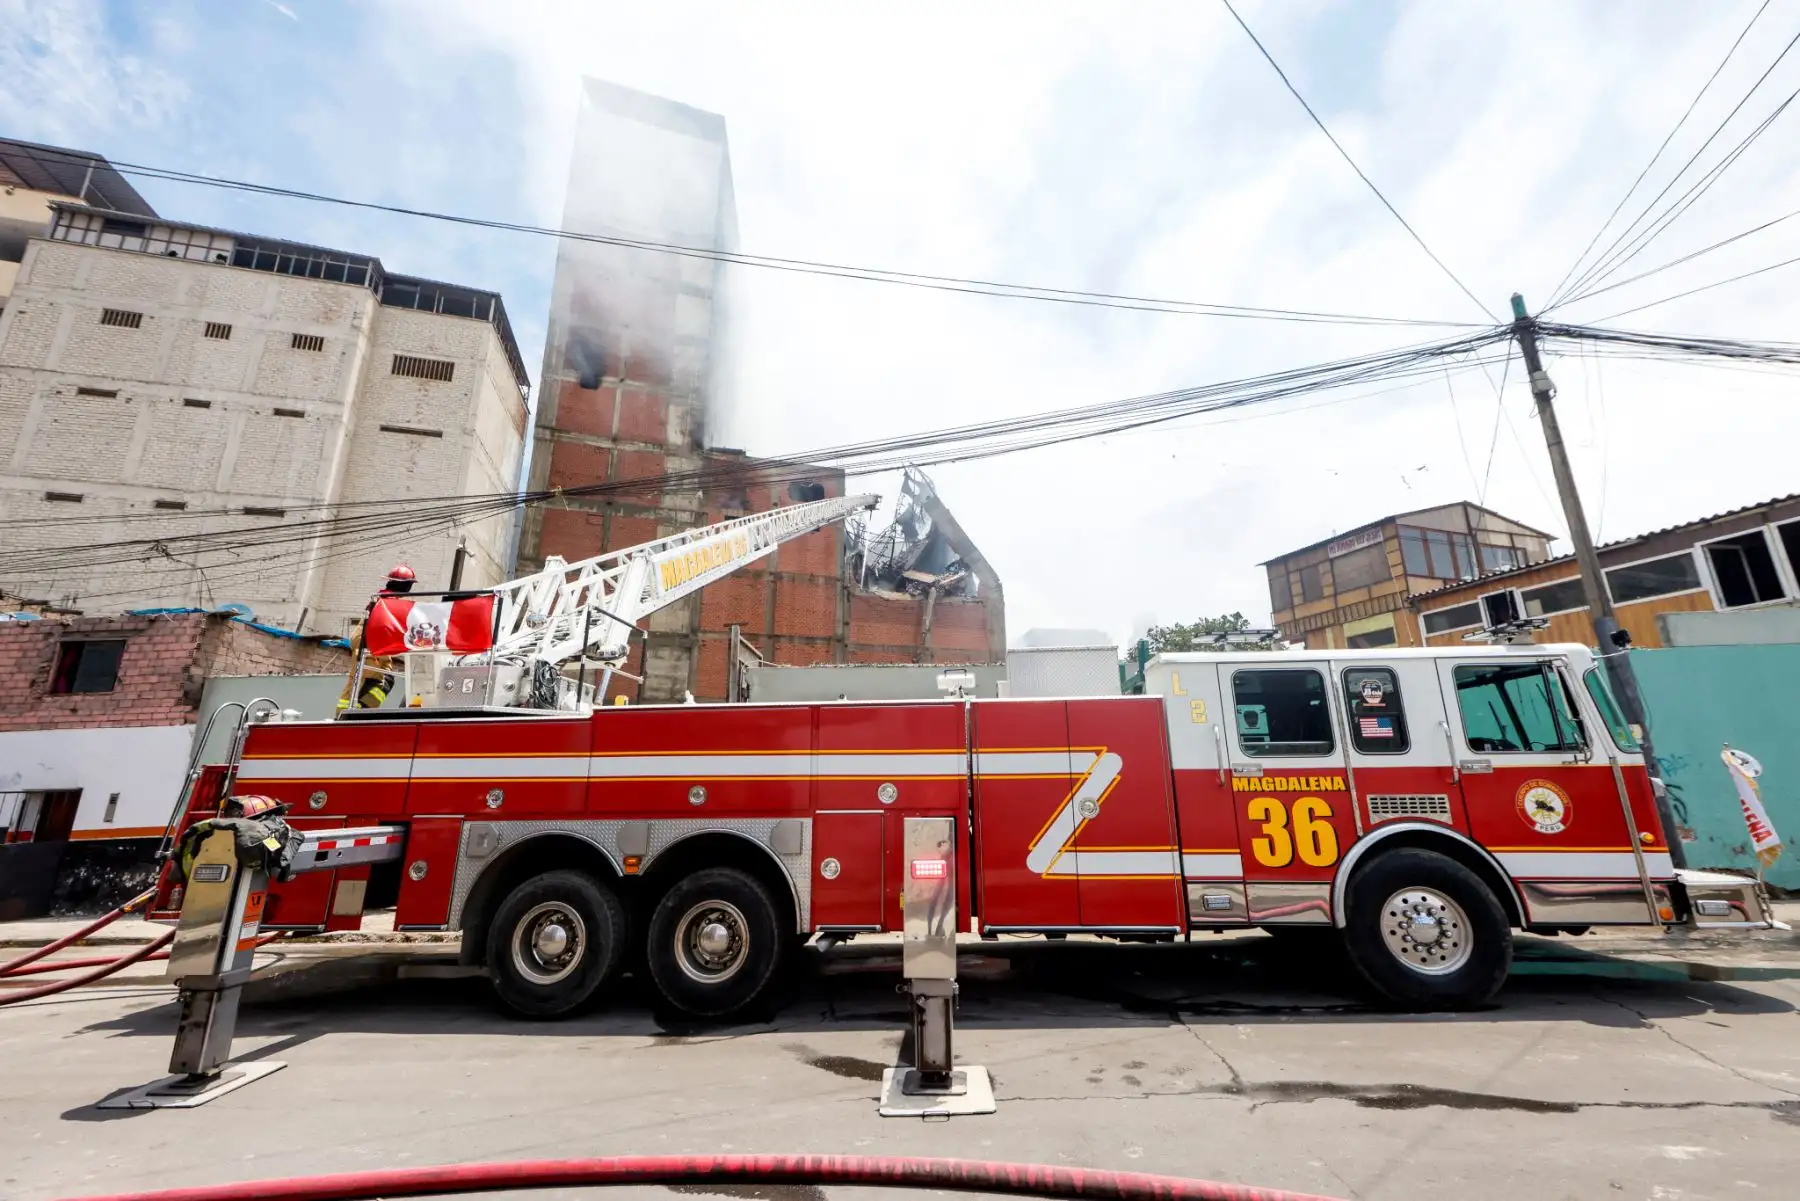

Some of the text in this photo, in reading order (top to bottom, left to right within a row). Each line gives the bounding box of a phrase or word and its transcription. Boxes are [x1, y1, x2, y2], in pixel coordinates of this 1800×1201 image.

[1172, 671, 1188, 696] L
[1190, 699, 1207, 723] 2
[1232, 776, 1347, 792] MAGDALENA
[1247, 796, 1340, 868] 36
